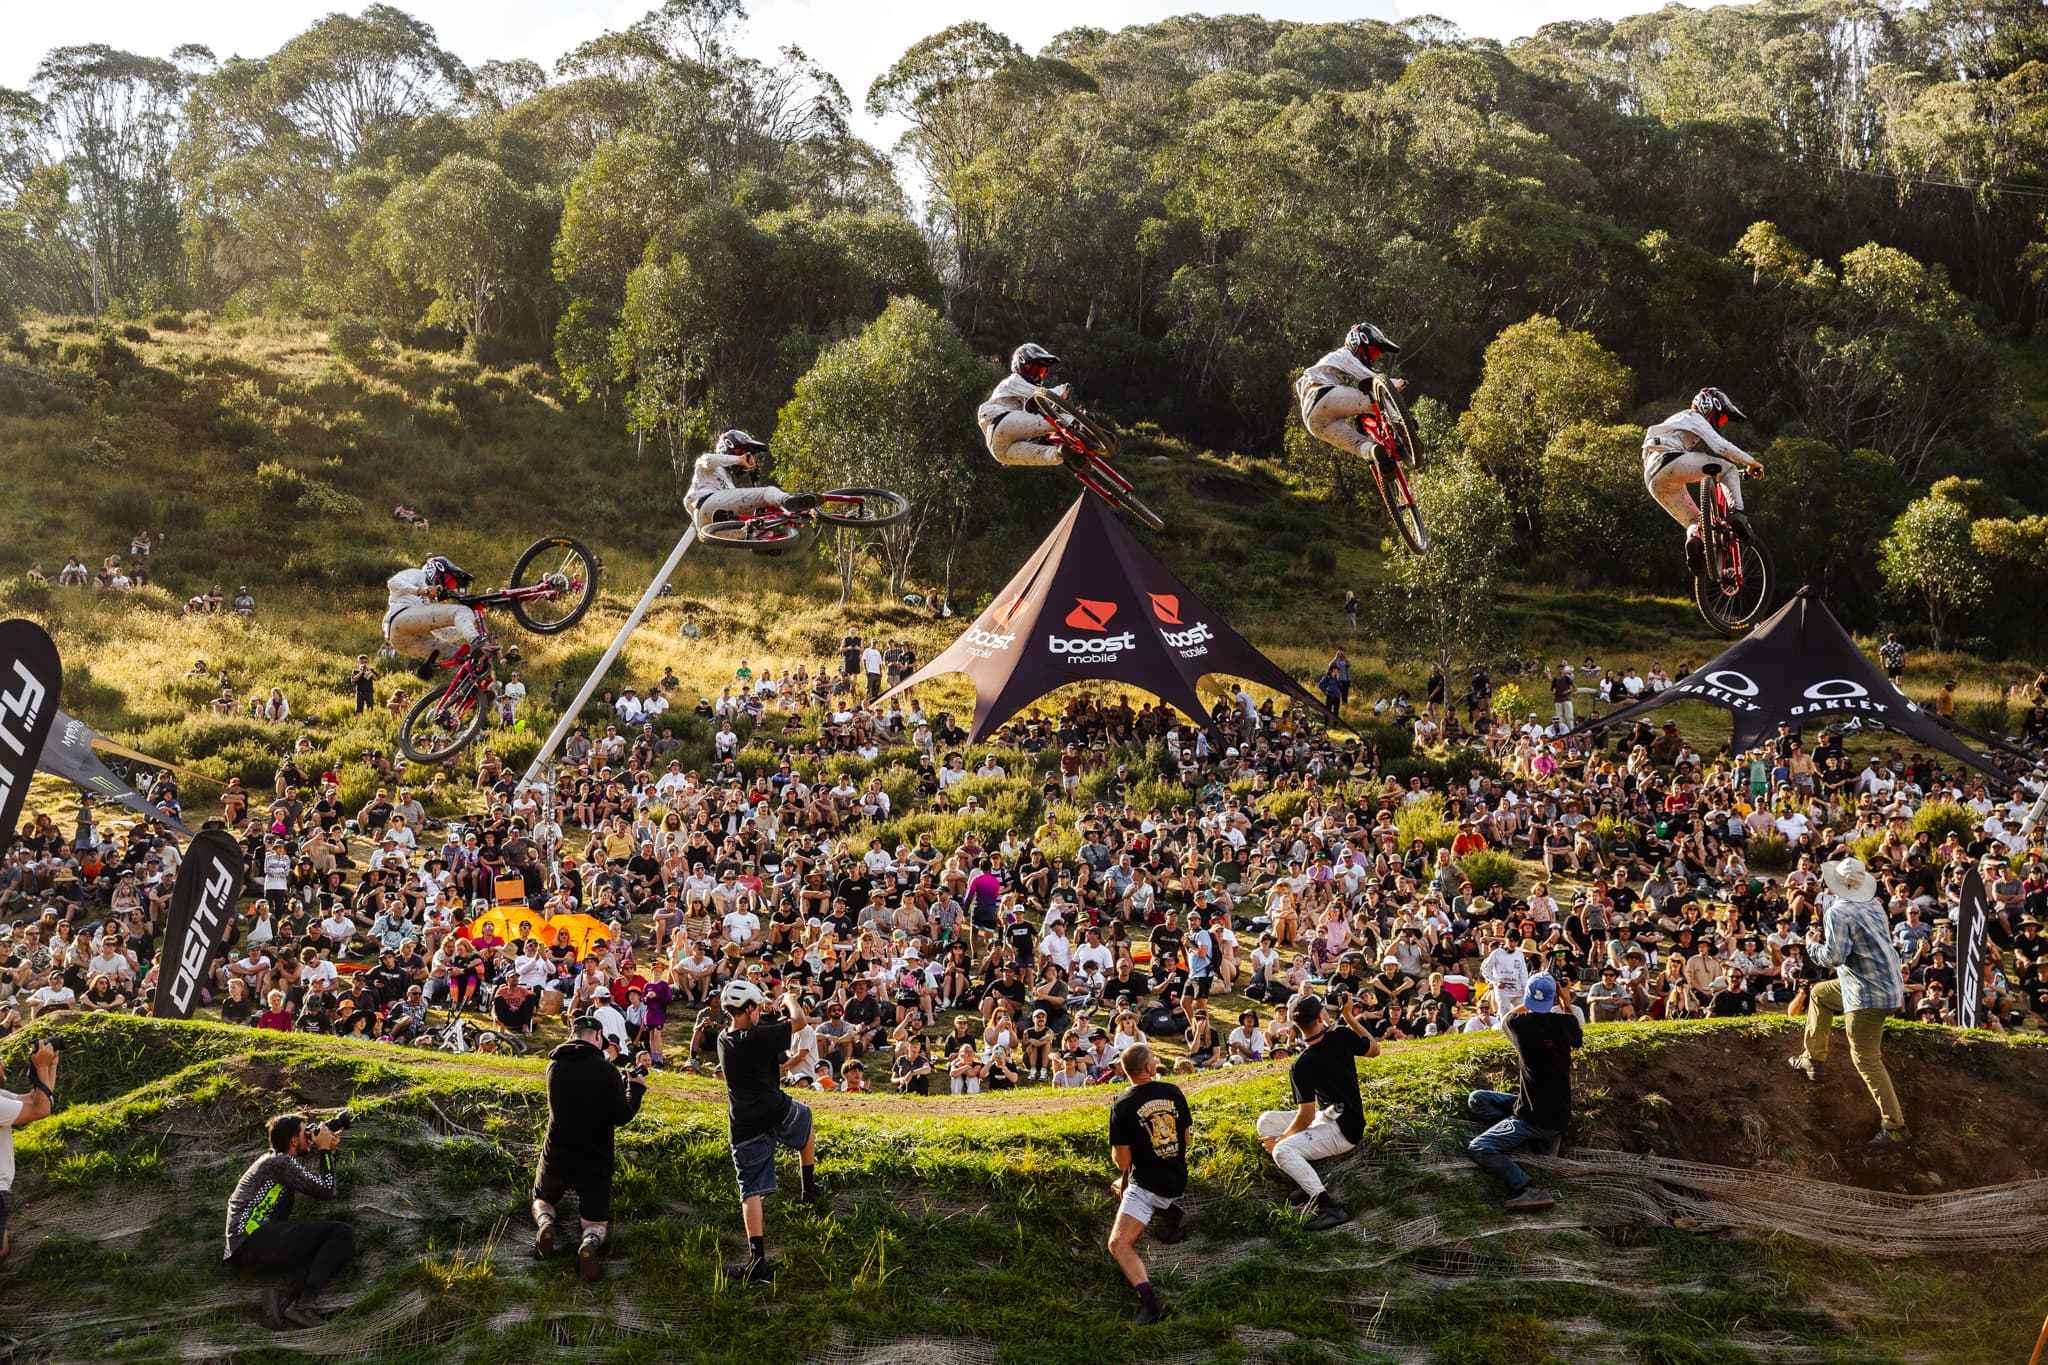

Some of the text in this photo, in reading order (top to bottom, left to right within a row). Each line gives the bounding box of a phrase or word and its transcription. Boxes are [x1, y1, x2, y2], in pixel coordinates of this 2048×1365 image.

[966, 624, 1016, 650] boost
[1048, 631, 1136, 654] boost
[1160, 621, 1215, 648] boost
[1067, 652, 1118, 664] mobile
[1179, 644, 1208, 659] mobile
[1679, 685, 1760, 711] OAKLEY
[1790, 698, 1886, 716] OAKLEY
[169, 855, 234, 1015] DEITY
[1962, 895, 1986, 1029] DEITY
